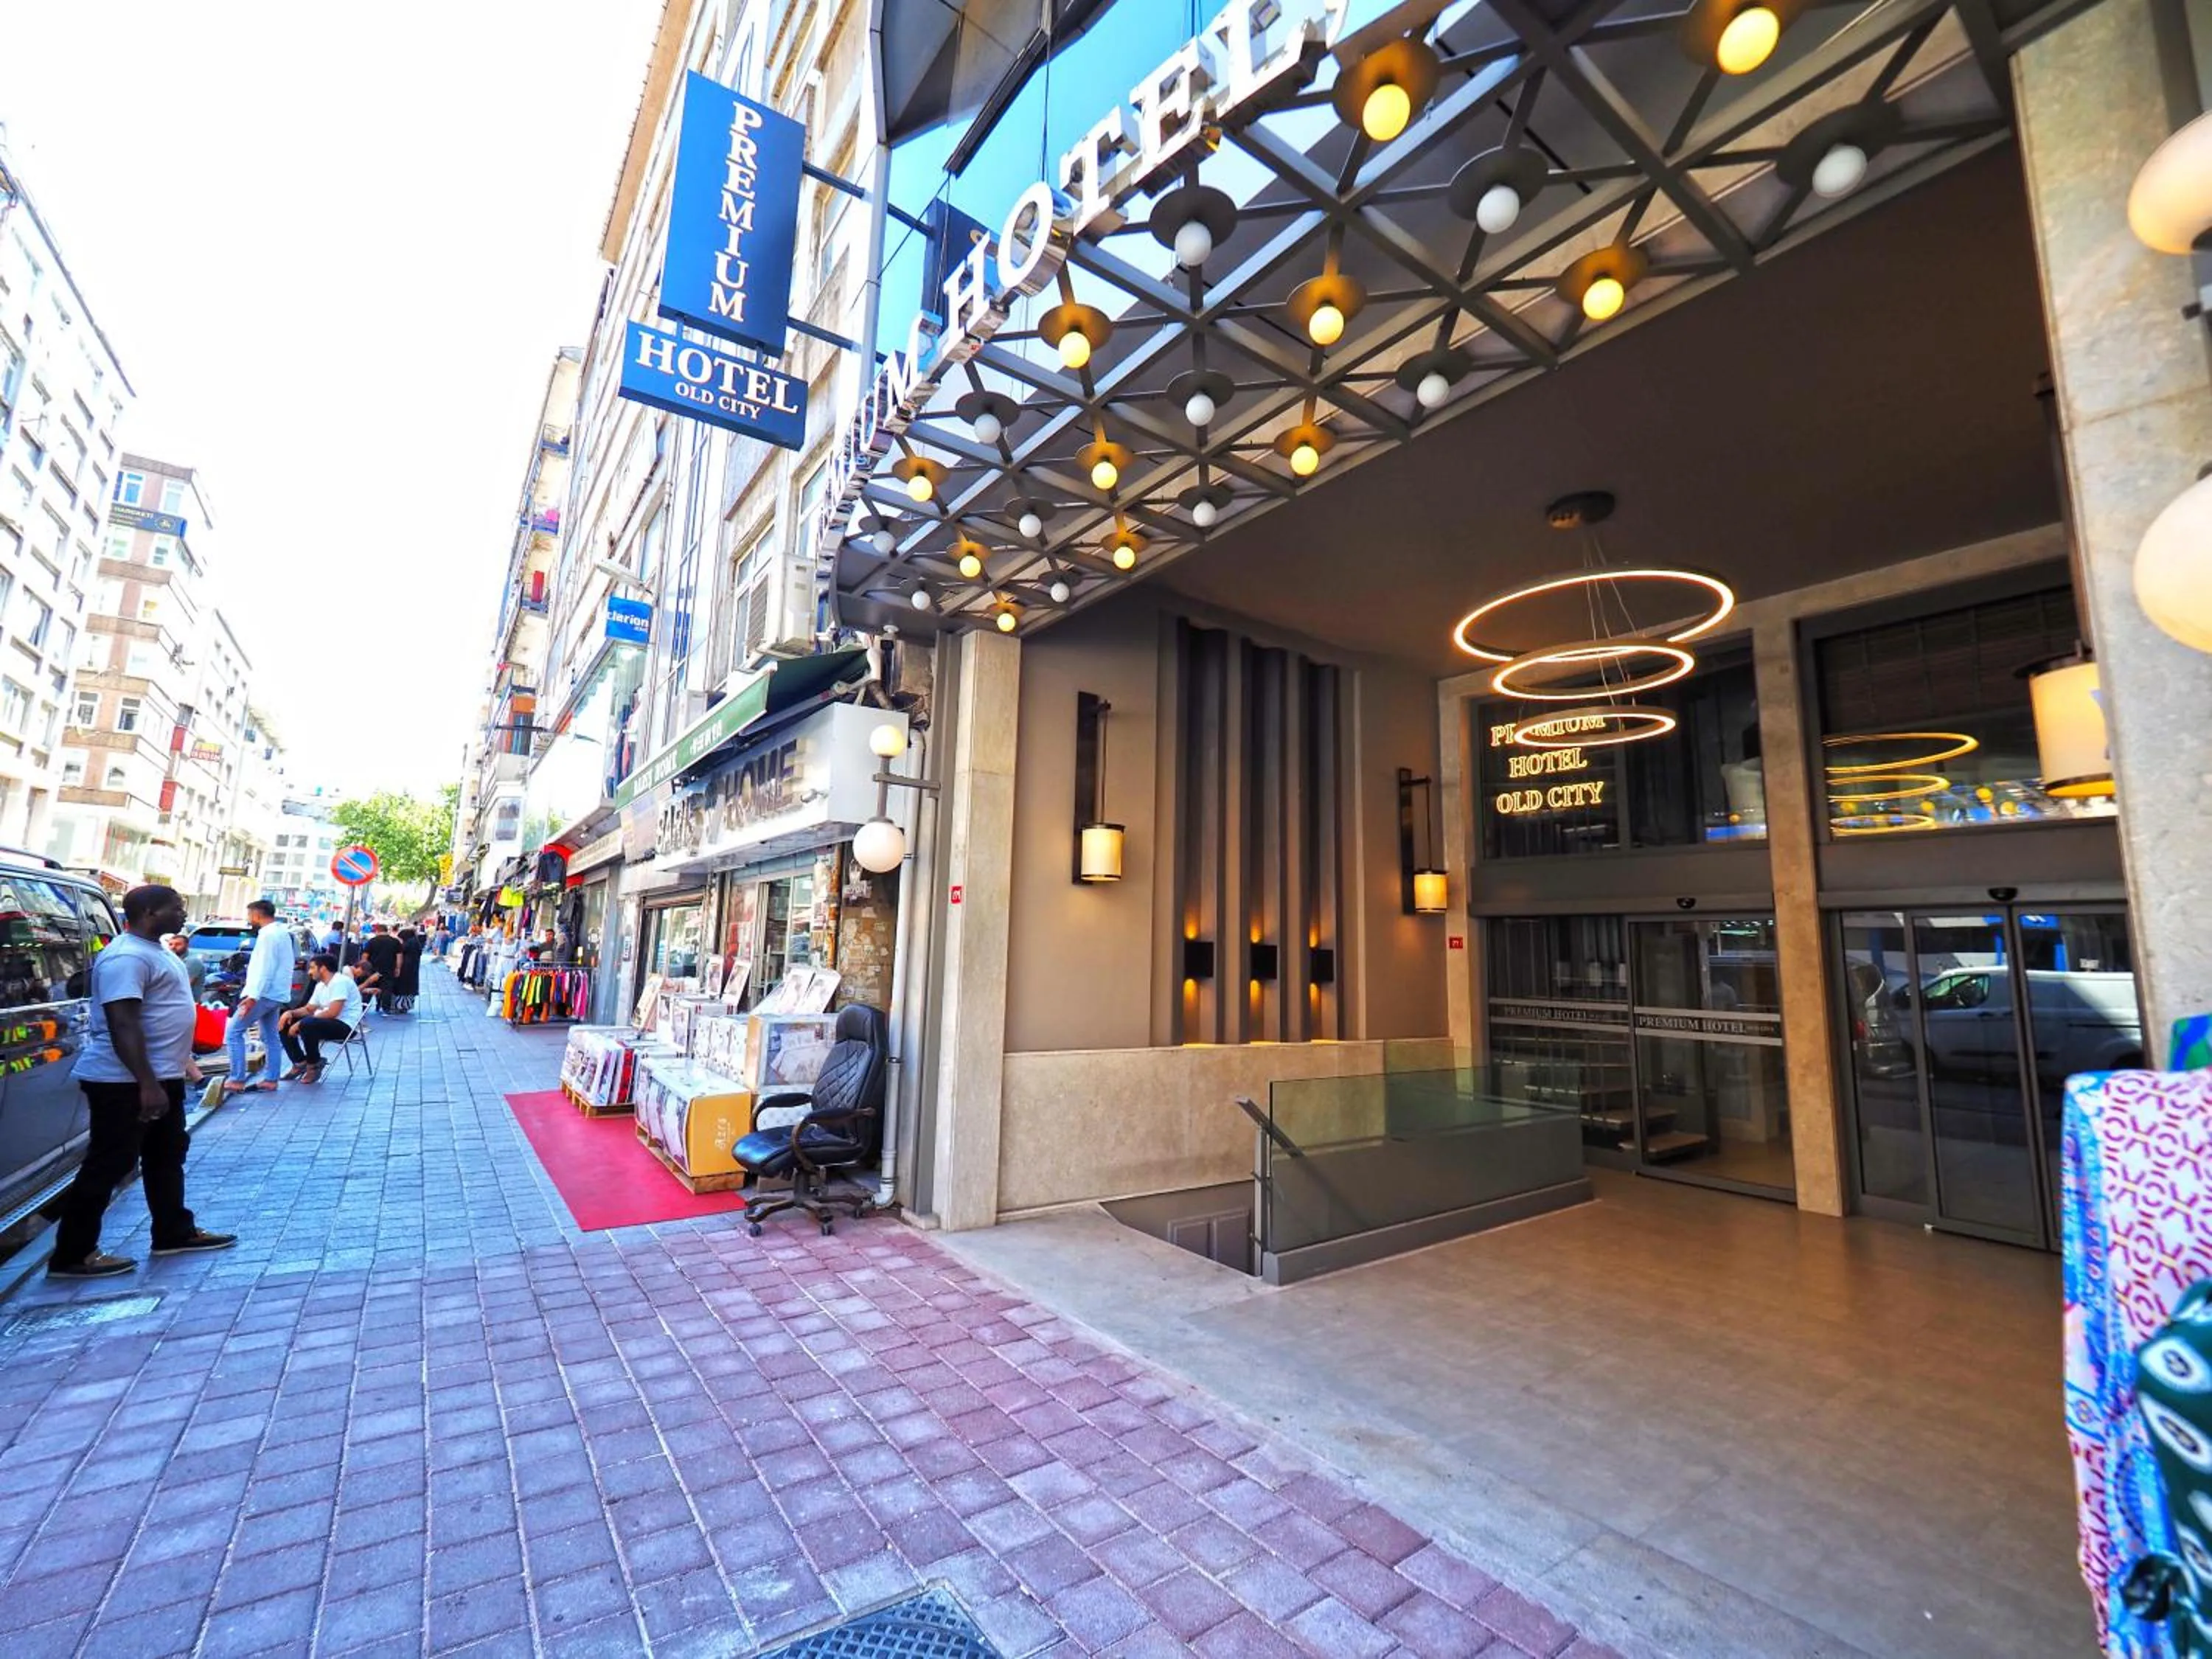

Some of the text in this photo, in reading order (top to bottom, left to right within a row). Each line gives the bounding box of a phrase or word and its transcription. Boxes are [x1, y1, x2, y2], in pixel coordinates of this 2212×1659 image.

[944, 0, 1310, 359] HOTEL
[708, 100, 762, 322] PREMIUM
[635, 330, 799, 414] HOTEL
[675, 382, 760, 420] OLD CITY
[1491, 714, 1606, 747] PMIUM
[1509, 748, 1587, 778] HOTEL
[1496, 782, 1604, 814] OLD CITY
[1505, 1006, 1549, 1019] PREMIUM
[1553, 1008, 1587, 1021] HOTEL
[1639, 1015, 1699, 1029] PREMIUM
[1702, 1019, 1746, 1033] HOTEL
